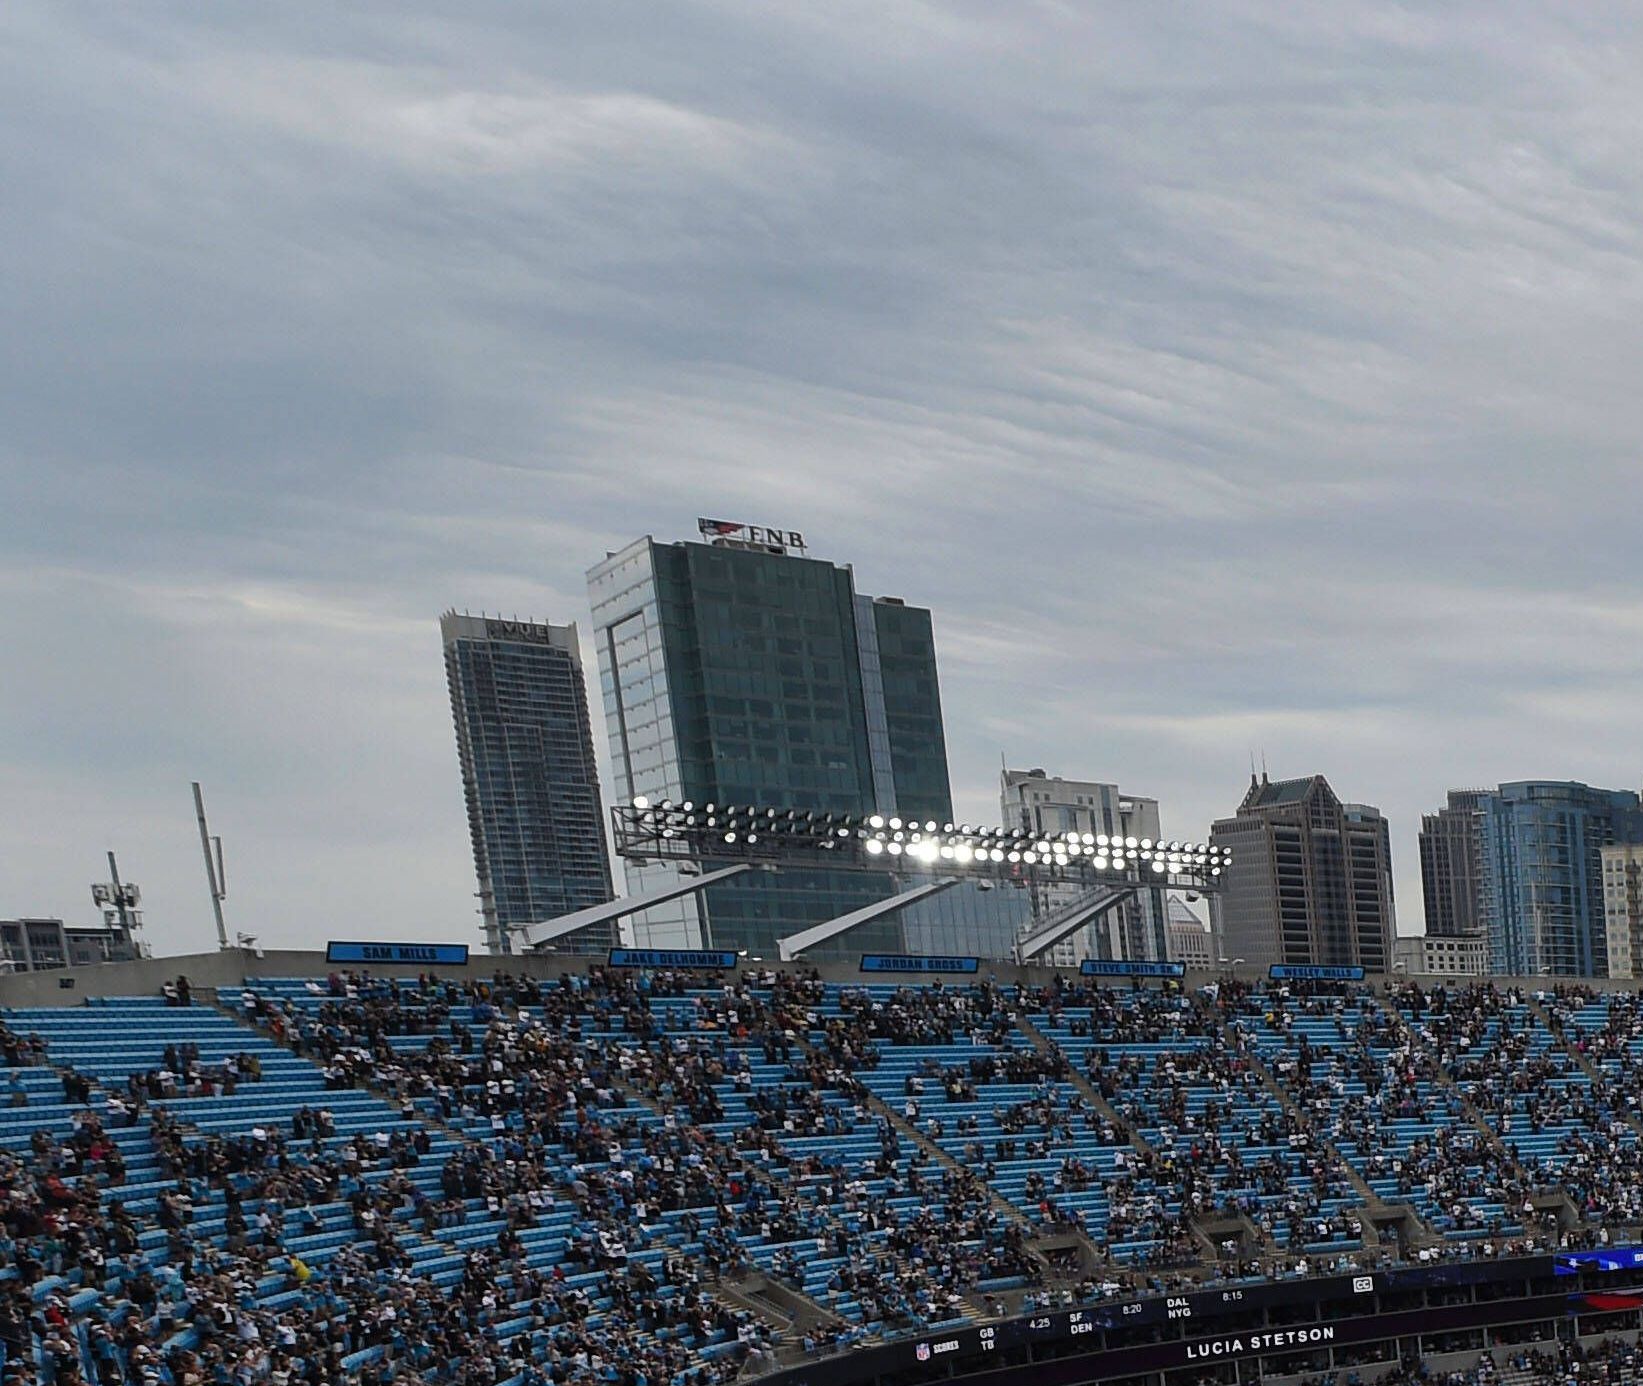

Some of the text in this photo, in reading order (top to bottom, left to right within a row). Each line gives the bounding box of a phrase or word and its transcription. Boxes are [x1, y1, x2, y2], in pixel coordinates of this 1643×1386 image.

[503, 621, 547, 638] VUE
[362, 945, 438, 961] SAM MILLS
[623, 951, 654, 965] JAKE
[927, 958, 964, 972] GROSS
[1131, 963, 1159, 975] SMITH
[1323, 967, 1353, 979] WALLS
[1222, 1290, 1243, 1302] 8:15
[1166, 1297, 1189, 1309] DAL
[1070, 1312, 1083, 1324] SF
[1168, 1307, 1192, 1320] NYG
[979, 1327, 994, 1339] GB
[1070, 1322, 1093, 1335] DEN
[1186, 1326, 1335, 1359] LUCIA STETSON
